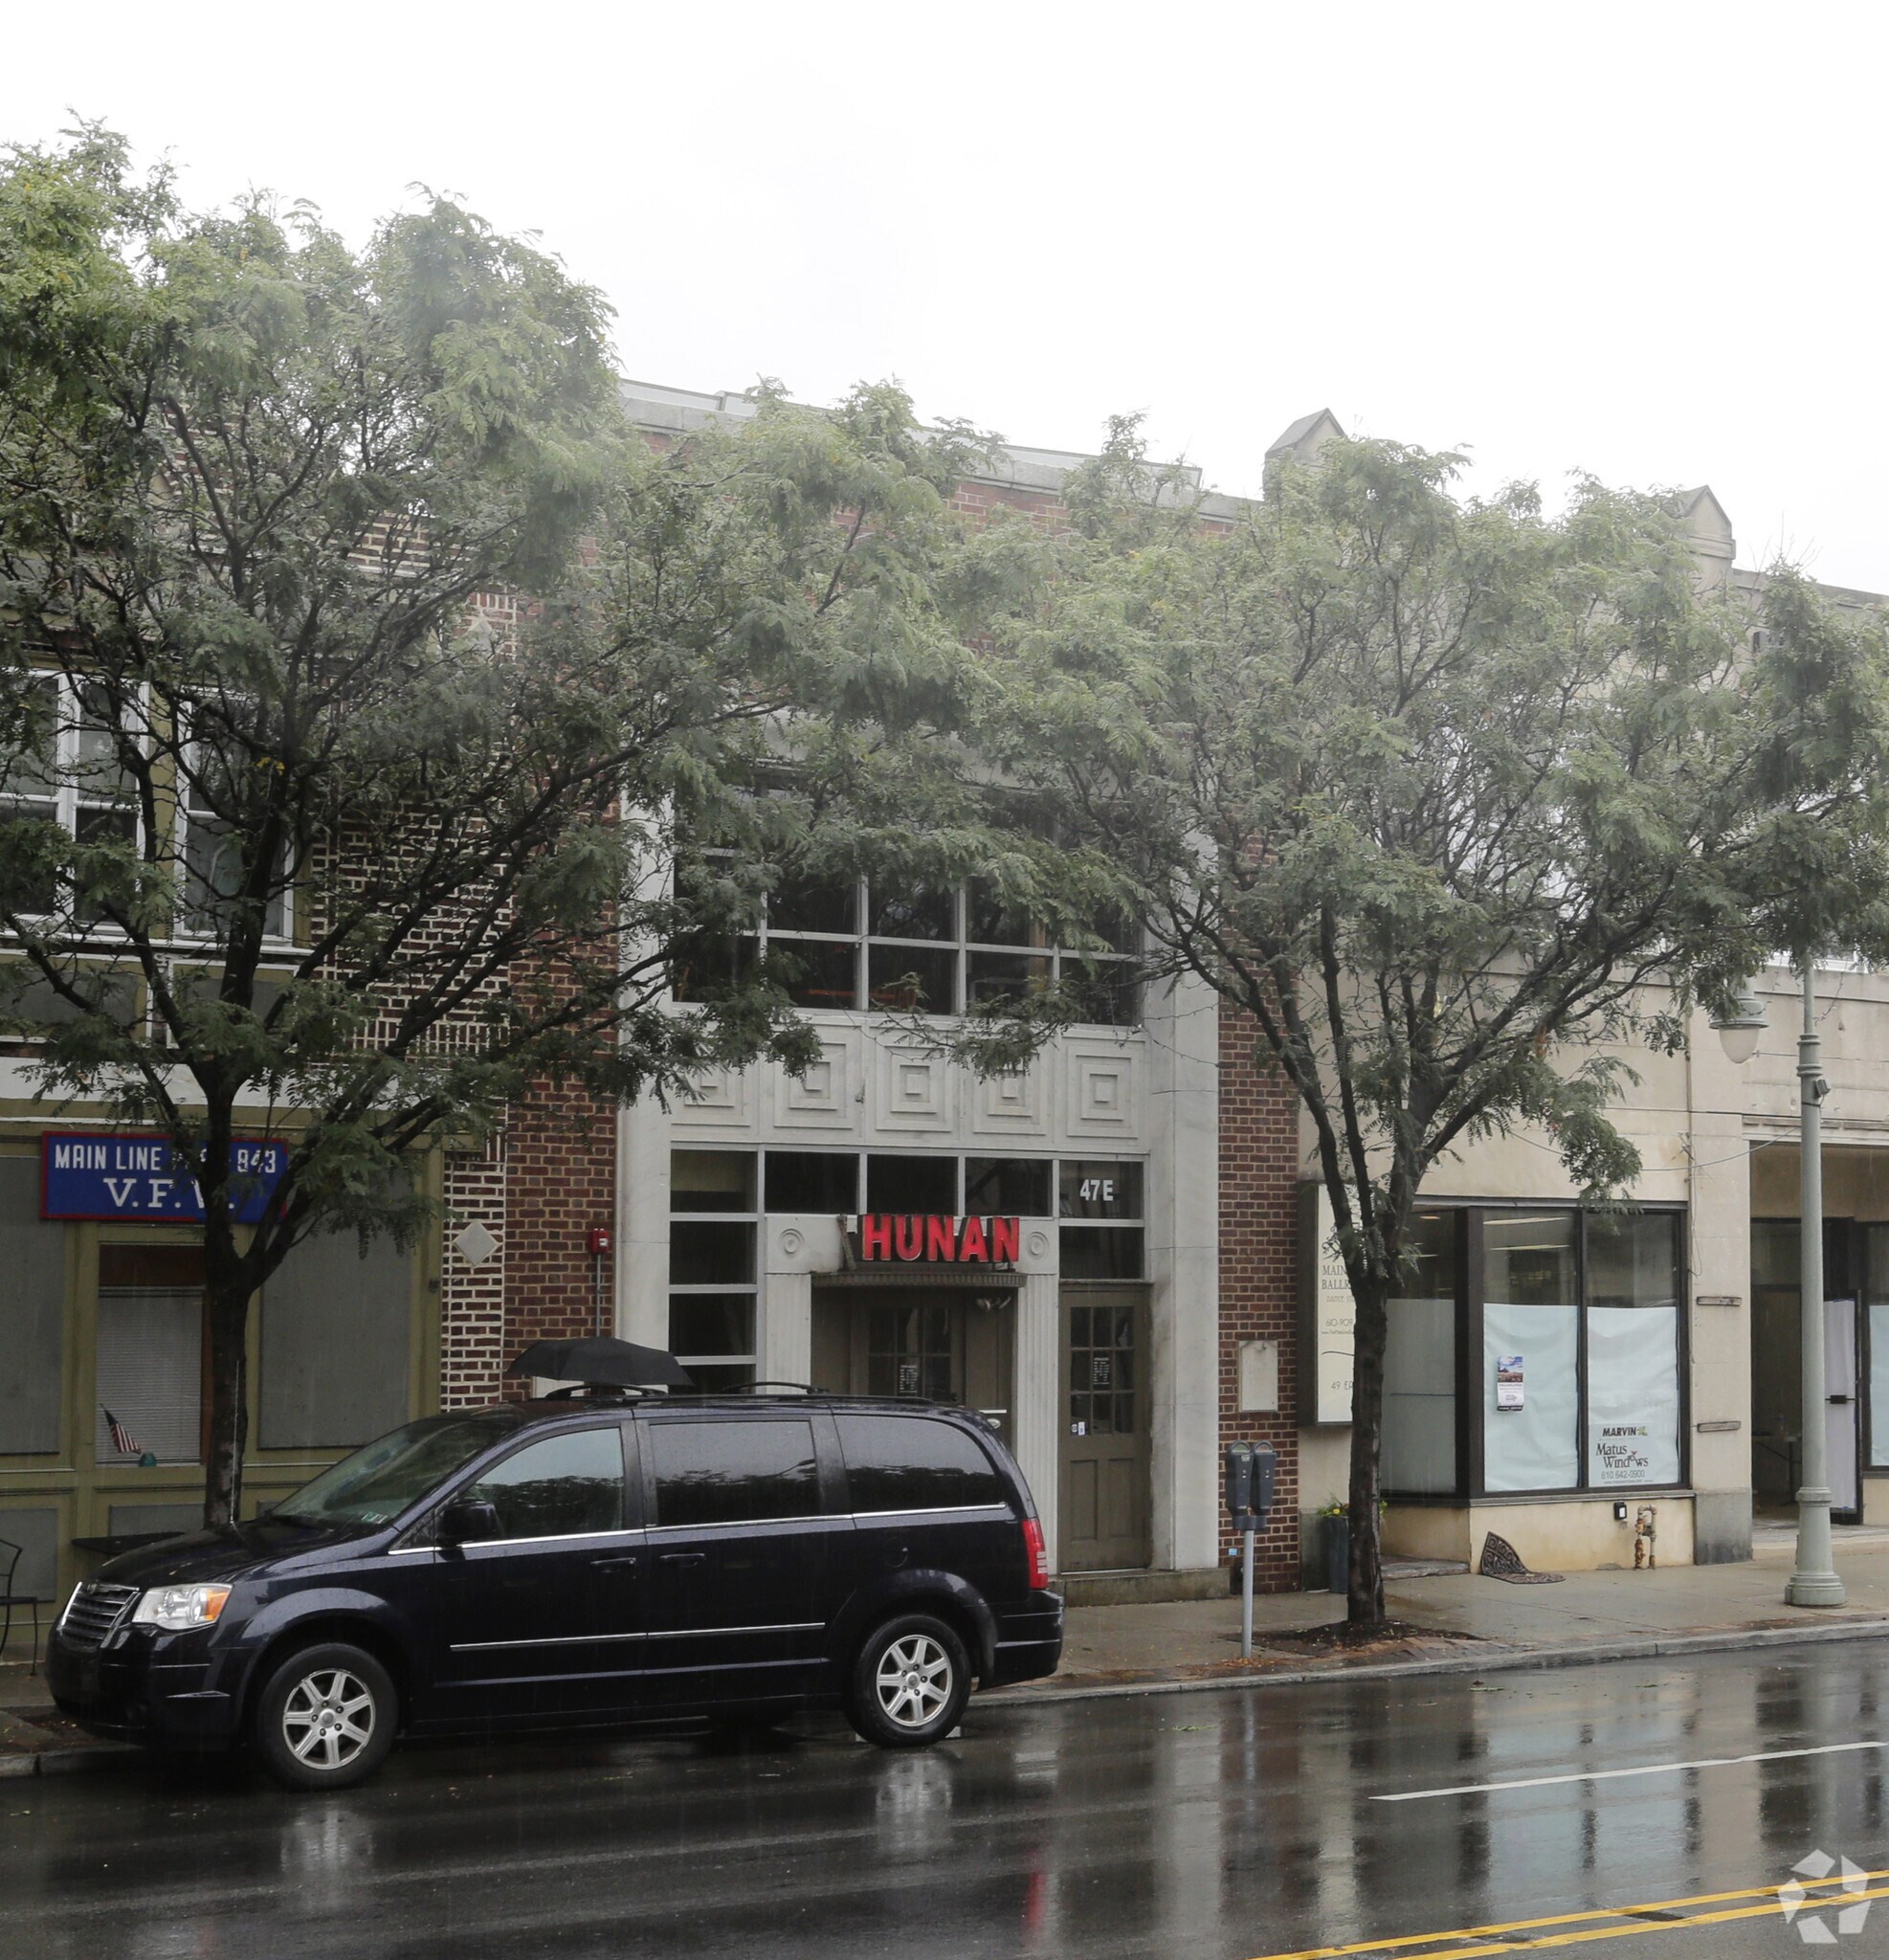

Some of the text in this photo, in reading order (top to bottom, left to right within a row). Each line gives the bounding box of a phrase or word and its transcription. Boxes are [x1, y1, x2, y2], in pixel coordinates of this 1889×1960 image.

[55, 1144, 106, 1169] MAIN
[116, 1147, 162, 1170] LINE
[862, 1214, 1020, 1262] HUNAN
[1322, 1264, 1347, 1276] MAIN
[1322, 1279, 1351, 1290] BALLR
[1602, 1427, 1636, 1437] MARVIN
[1596, 1442, 1628, 1456] Matus
[1603, 1455, 1649, 1468] Windows
